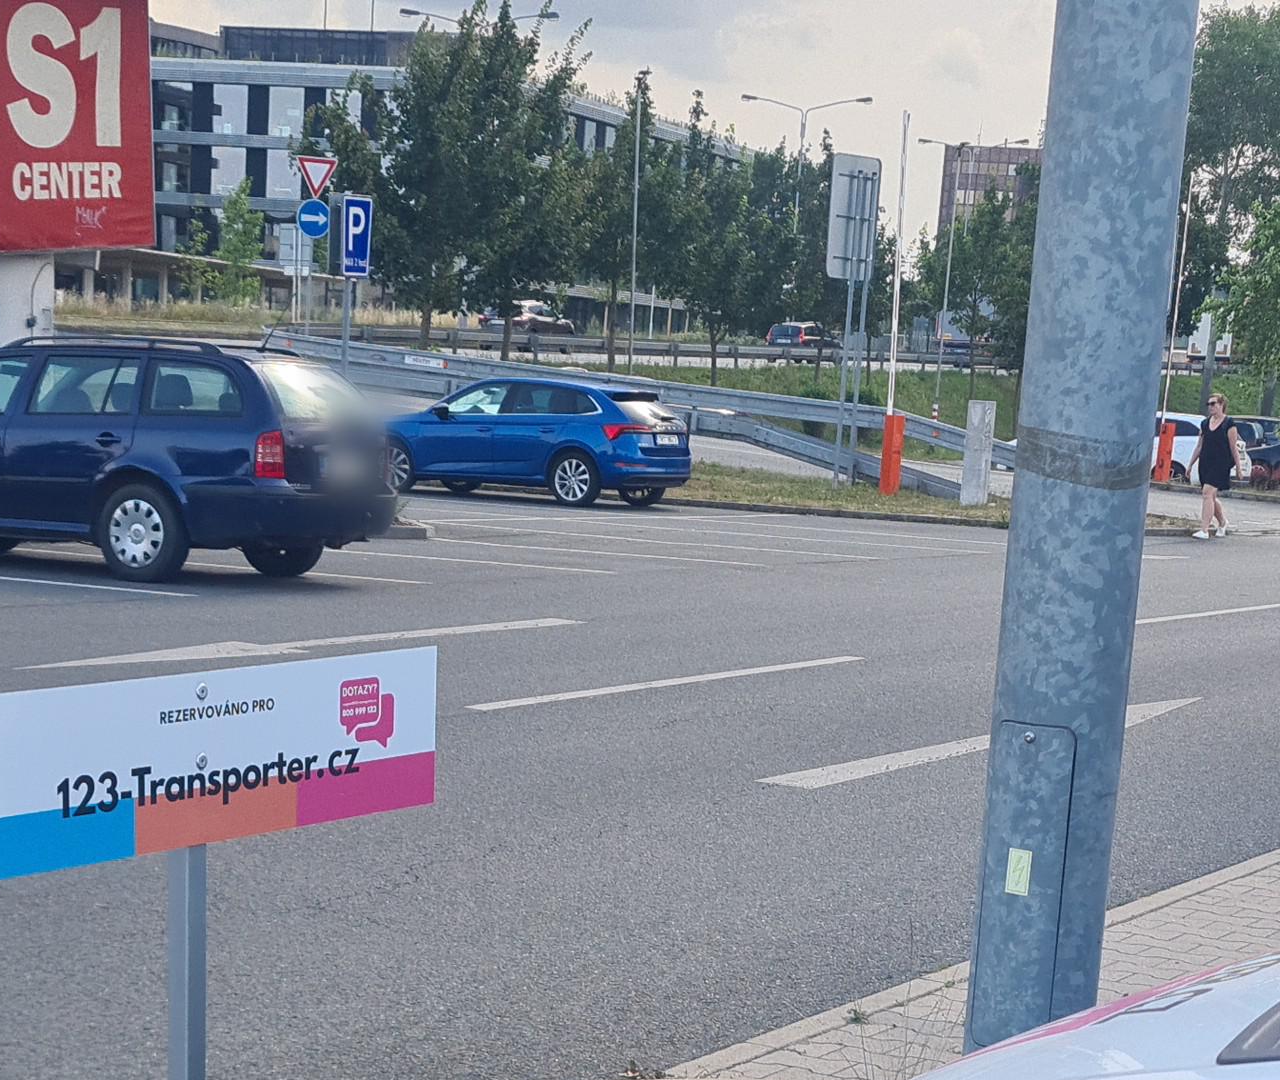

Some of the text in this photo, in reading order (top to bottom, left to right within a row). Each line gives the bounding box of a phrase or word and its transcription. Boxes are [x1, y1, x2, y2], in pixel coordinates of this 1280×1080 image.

[6, 2, 122, 149] S1
[12, 161, 122, 201] CENTER
[348, 206, 366, 252] P
[159, 698, 275, 725] REZERVOVÁNO PRO
[342, 683, 378, 697] DOTAZY?
[56, 748, 361, 818] 123-Transporter.cz
